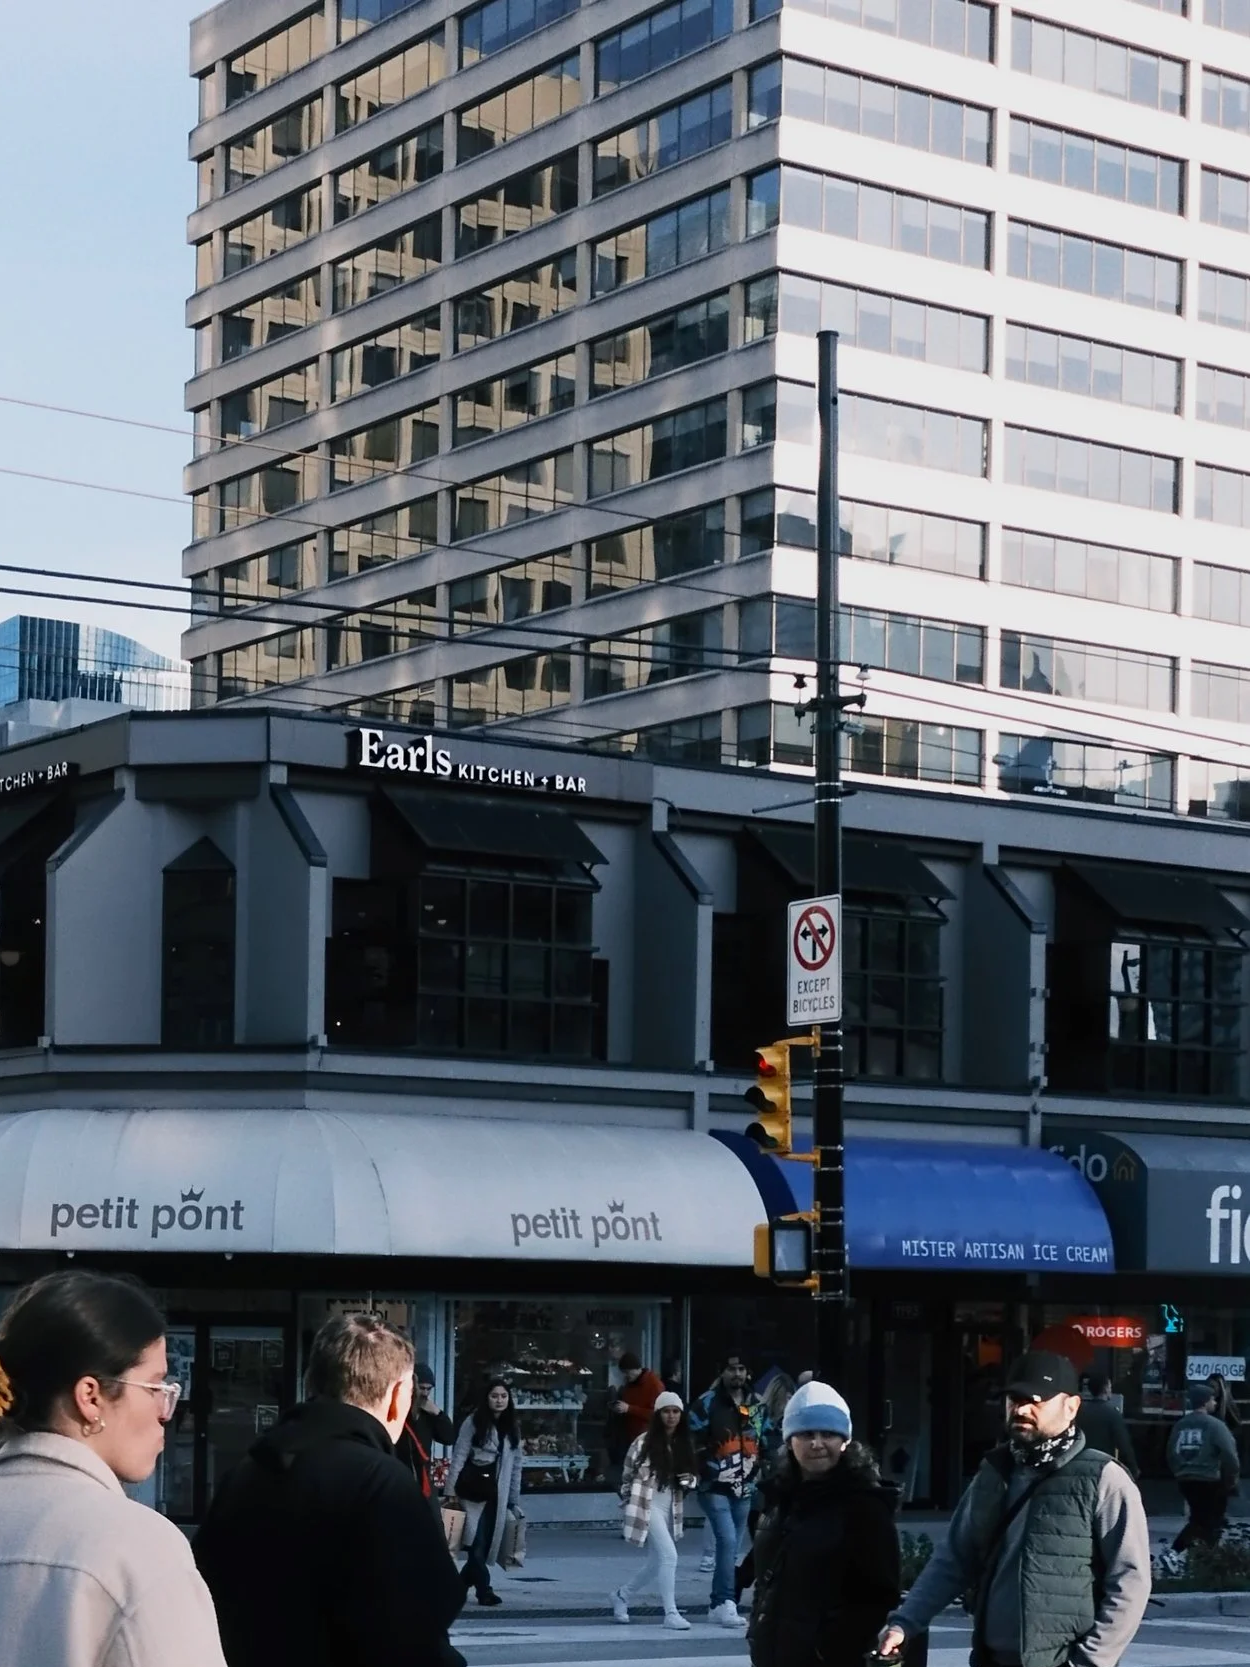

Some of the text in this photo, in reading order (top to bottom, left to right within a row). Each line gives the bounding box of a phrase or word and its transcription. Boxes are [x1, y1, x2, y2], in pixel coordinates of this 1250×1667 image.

[47, 761, 68, 780] BAR
[359, 727, 452, 776] Earls
[458, 763, 535, 787] KITCHEN
[555, 775, 587, 793] BAR
[797, 977, 830, 994] EXCEPT
[793, 996, 835, 1013] BICYCLES
[50, 1196, 139, 1237] petit
[511, 1207, 583, 1246] petit
[1206, 1185, 1250, 1264] fi
[901, 1240, 1108, 1263] MISTER ARTISAN ICE CREAM
[1086, 1326, 1142, 1338] ROGERS
[1188, 1362, 1245, 1377] $40/60GB
